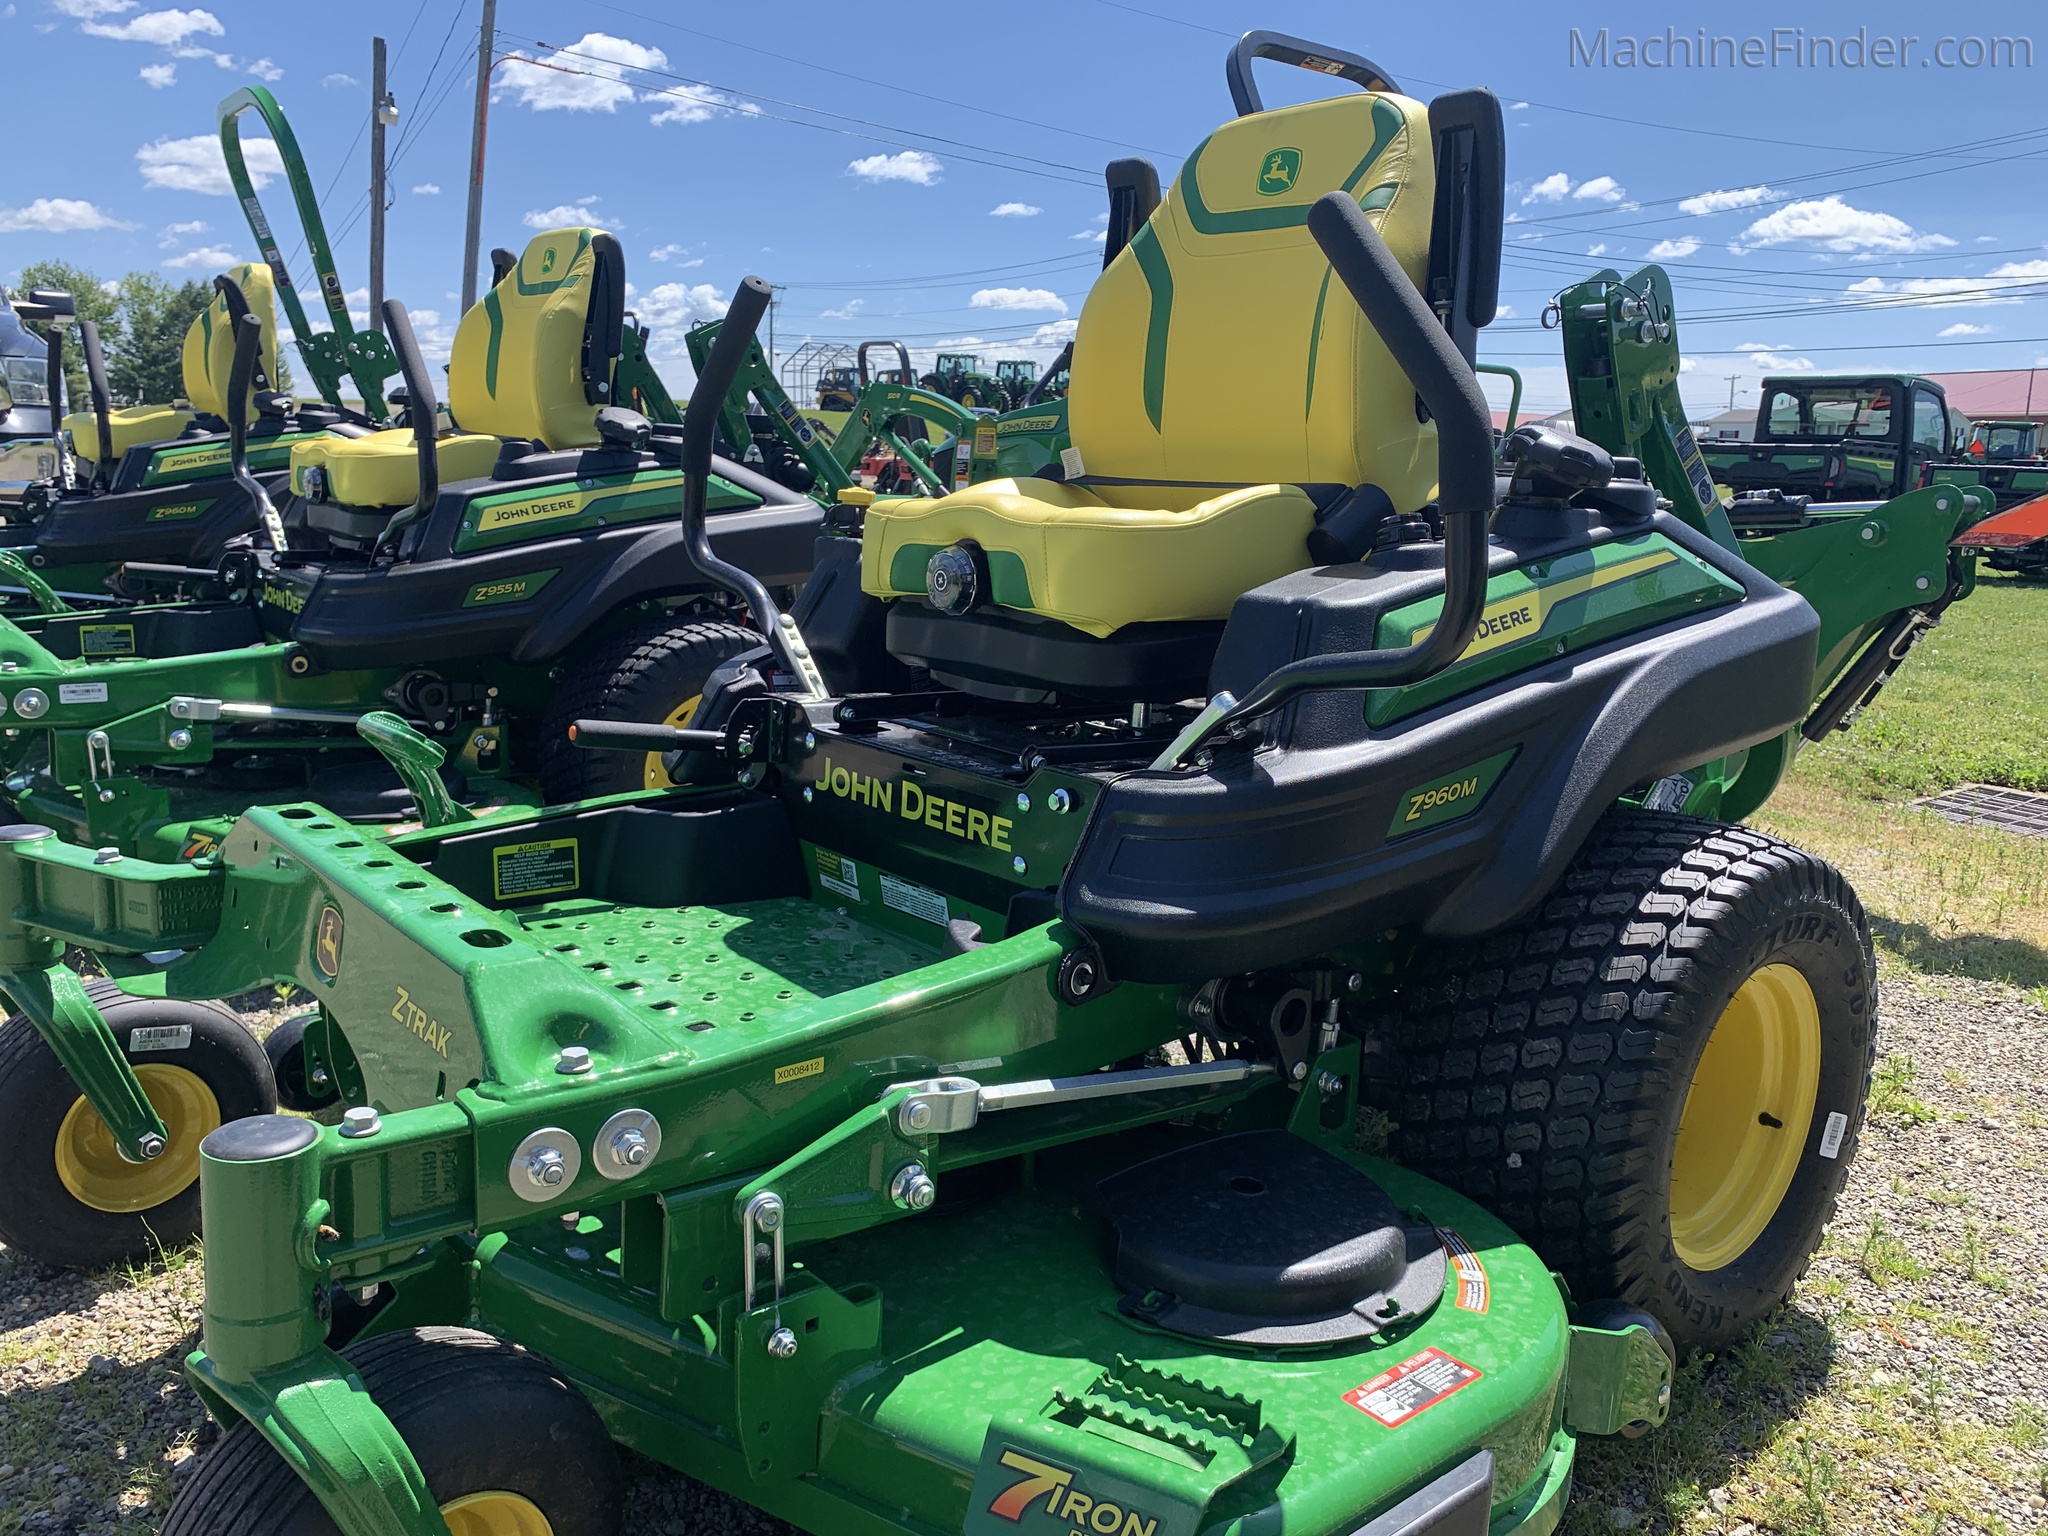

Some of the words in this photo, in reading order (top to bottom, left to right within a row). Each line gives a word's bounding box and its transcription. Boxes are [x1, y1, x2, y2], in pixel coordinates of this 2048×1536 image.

[171, 458, 197, 467] JOHN
[155, 506, 197, 518] Z960M
[494, 507, 529, 522] JOHN
[531, 500, 576, 515] DEERE
[474, 581, 526, 601] Z955M
[1478, 606, 1533, 640] DEERE
[815, 757, 893, 813] JOHN
[901, 780, 1013, 853] DEERE
[1405, 776, 1478, 822] Z960M
[525, 843, 551, 851] CAUTION
[1765, 914, 1838, 955] TURF
[391, 985, 453, 1060] ZTRAK
[777, 1061, 819, 1080] X0008412
